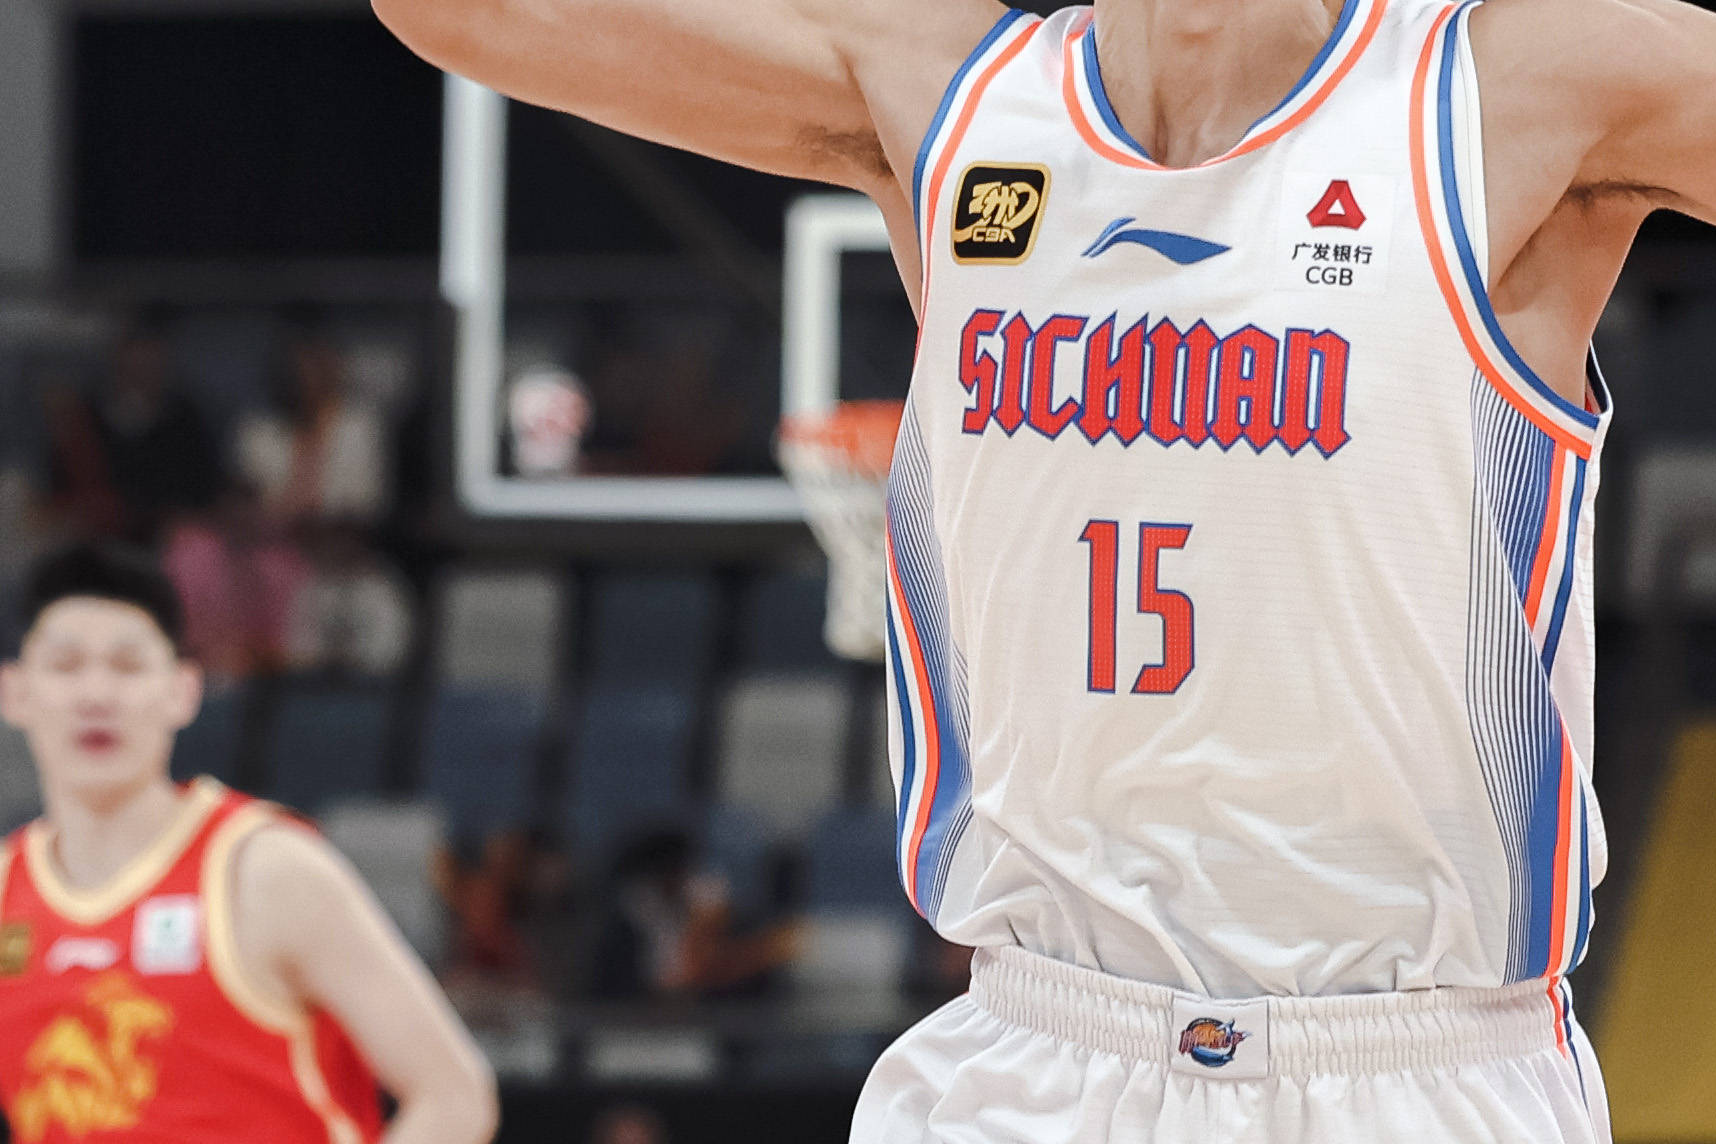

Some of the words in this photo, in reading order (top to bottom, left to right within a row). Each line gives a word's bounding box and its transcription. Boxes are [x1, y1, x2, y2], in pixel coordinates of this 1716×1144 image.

[1291, 241, 1374, 265] 广发银行
[1305, 265, 1354, 287] CGB
[959, 308, 1352, 461] SICHUAN
[1077, 519, 1195, 695] 15
